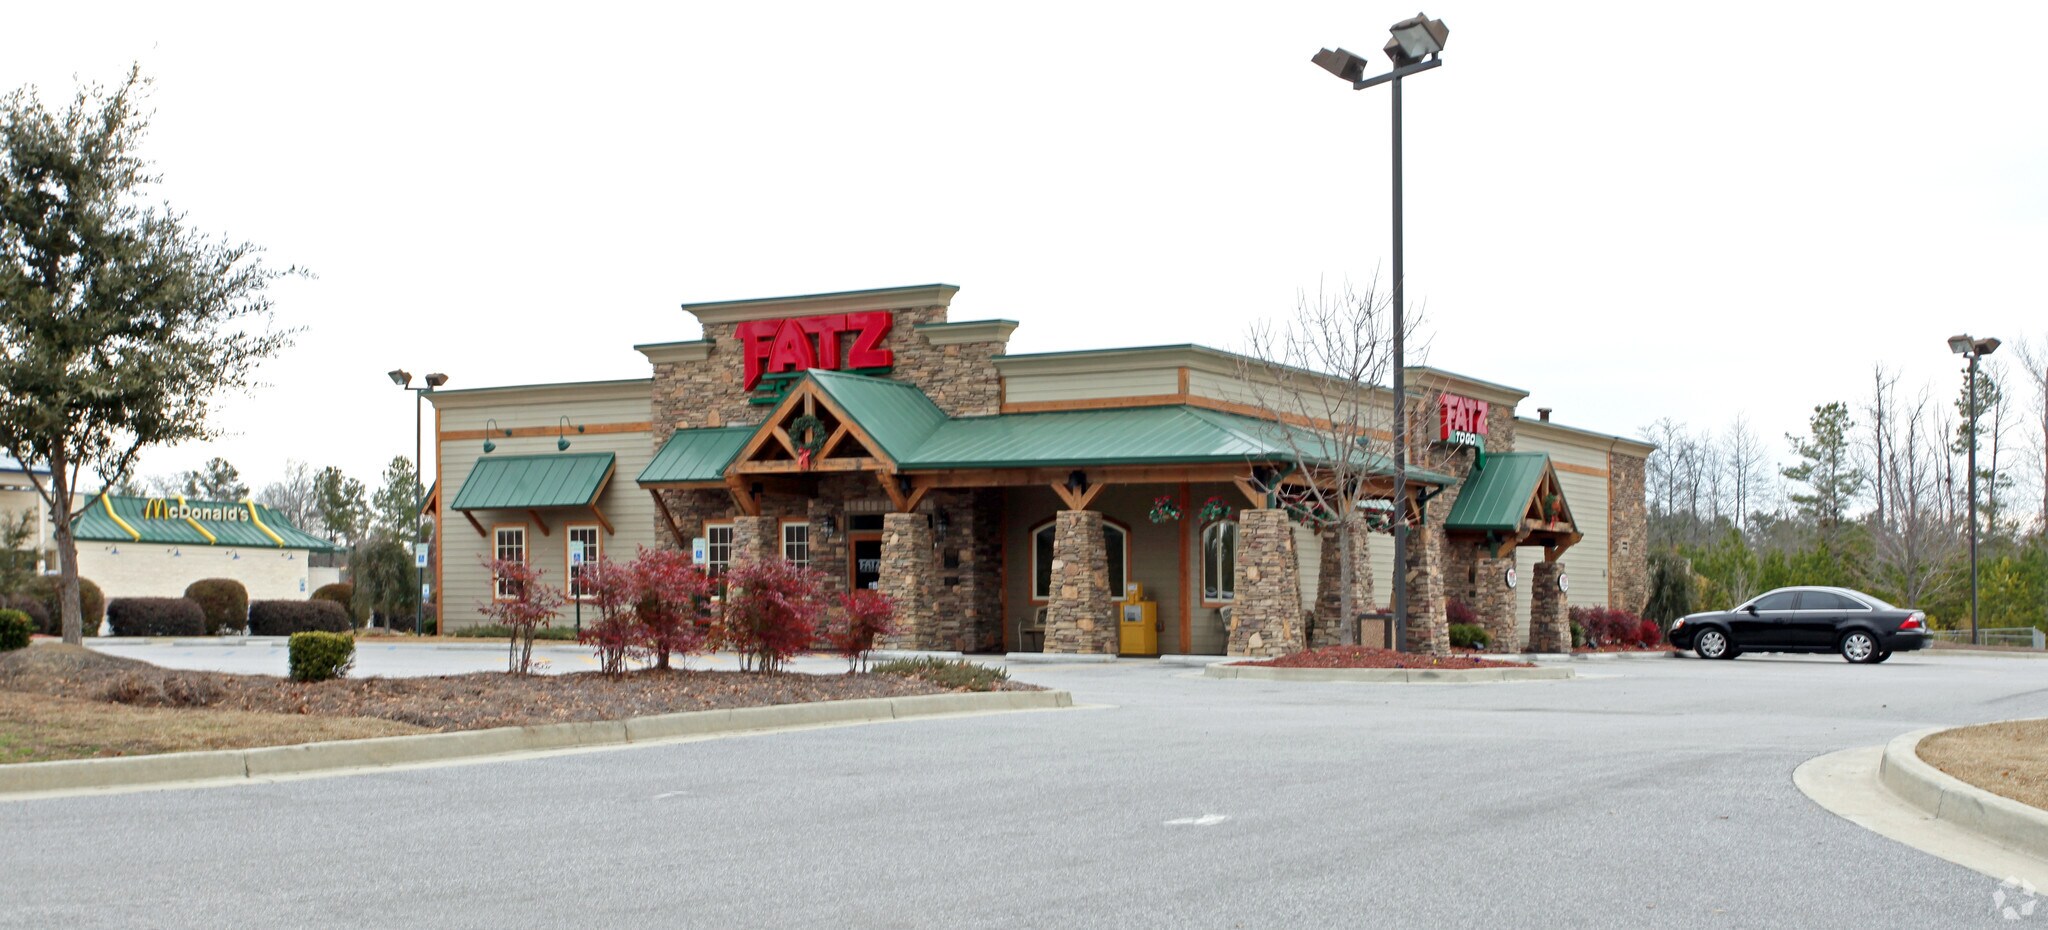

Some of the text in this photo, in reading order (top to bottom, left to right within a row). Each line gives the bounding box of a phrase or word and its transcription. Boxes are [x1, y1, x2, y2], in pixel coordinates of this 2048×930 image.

[733, 310, 893, 391] FATZ
[1440, 393, 1488, 440] FATZ
[144, 498, 249, 522] McDonald's
